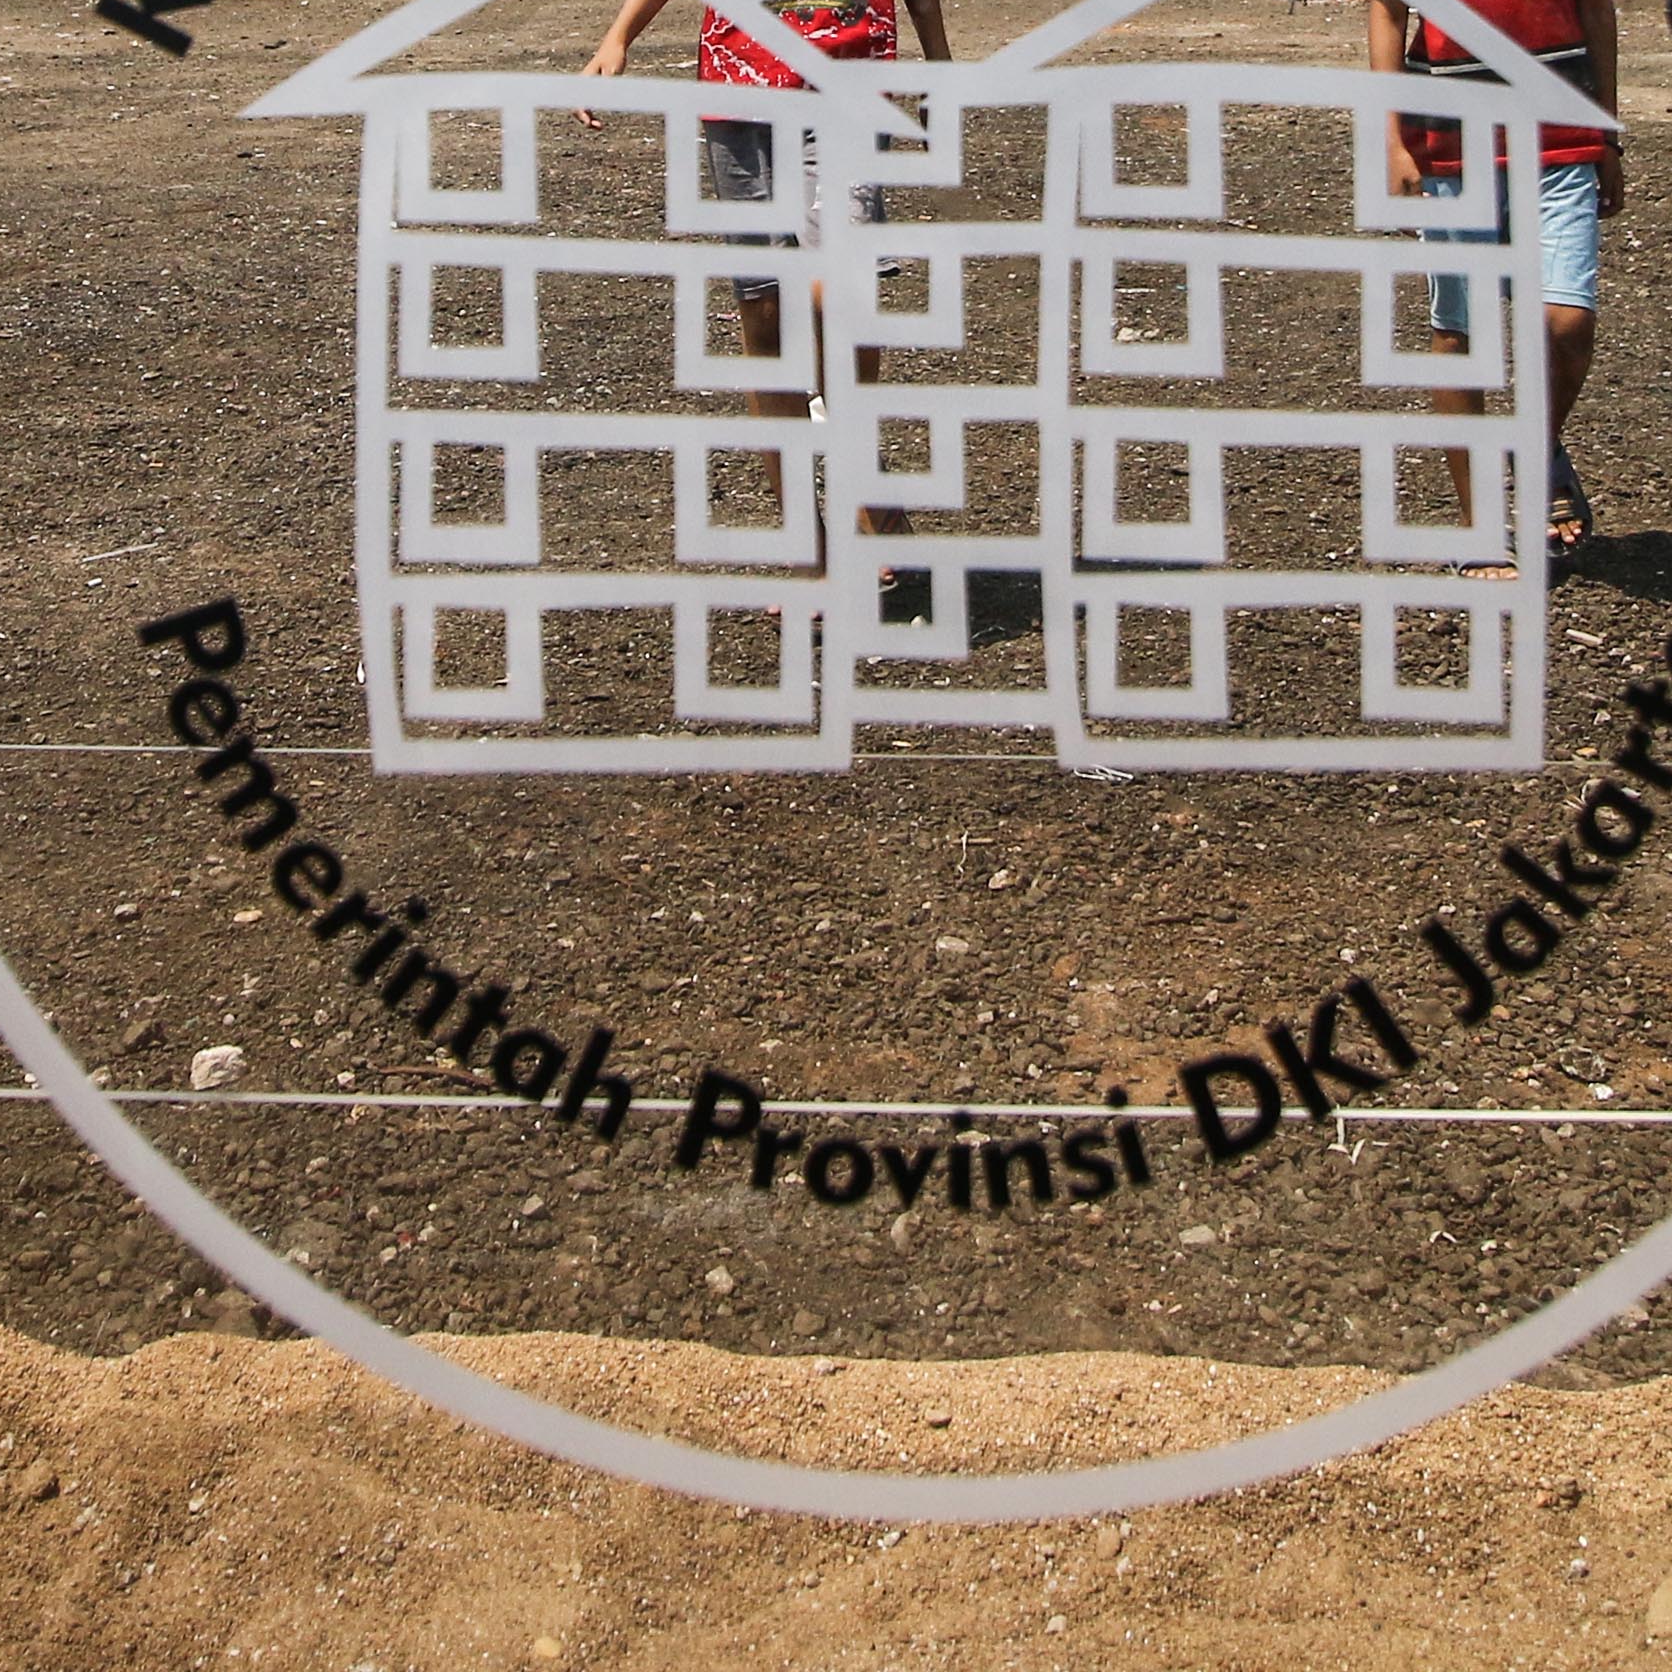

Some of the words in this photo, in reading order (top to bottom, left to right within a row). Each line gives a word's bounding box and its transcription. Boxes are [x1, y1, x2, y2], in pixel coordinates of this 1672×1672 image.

[139, 596, 635, 1142] Pemerintah
[674, 1070, 1151, 1212] Provinsi
[1179, 976, 1420, 1165] DKI
